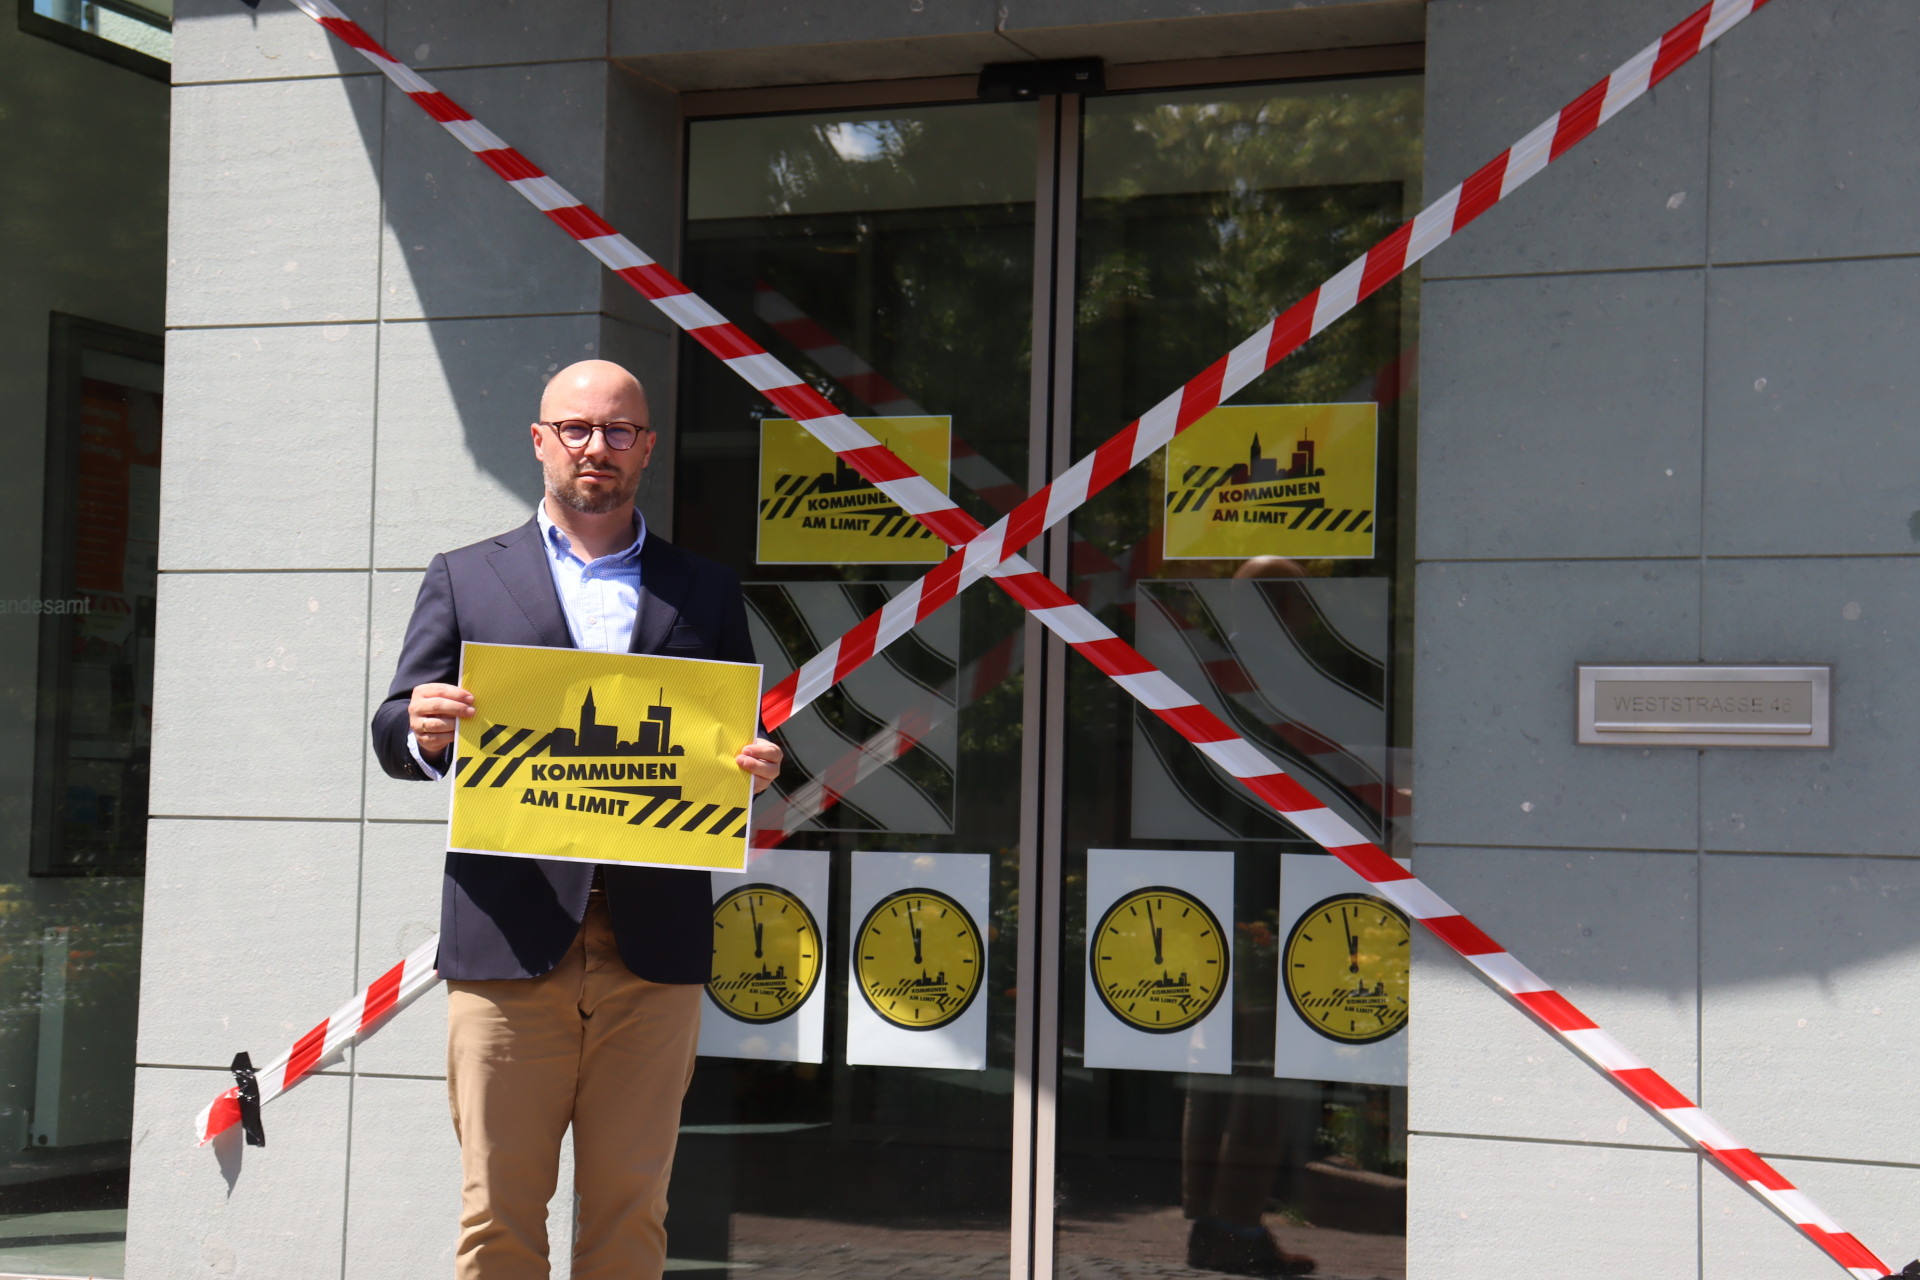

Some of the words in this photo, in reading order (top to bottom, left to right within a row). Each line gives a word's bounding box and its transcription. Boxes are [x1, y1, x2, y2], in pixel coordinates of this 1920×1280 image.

[1219, 482, 1320, 504] KOMMUNEN
[801, 516, 826, 529] AM
[830, 518, 871, 531] LIMIT
[1212, 509, 1239, 522] AM
[1243, 511, 1289, 524] LIMIT
[1613, 696, 1764, 713] WESTSTRASSE
[531, 763, 677, 781] KOMMUNEN
[520, 788, 559, 808] AM
[565, 793, 629, 816] LIMIT
